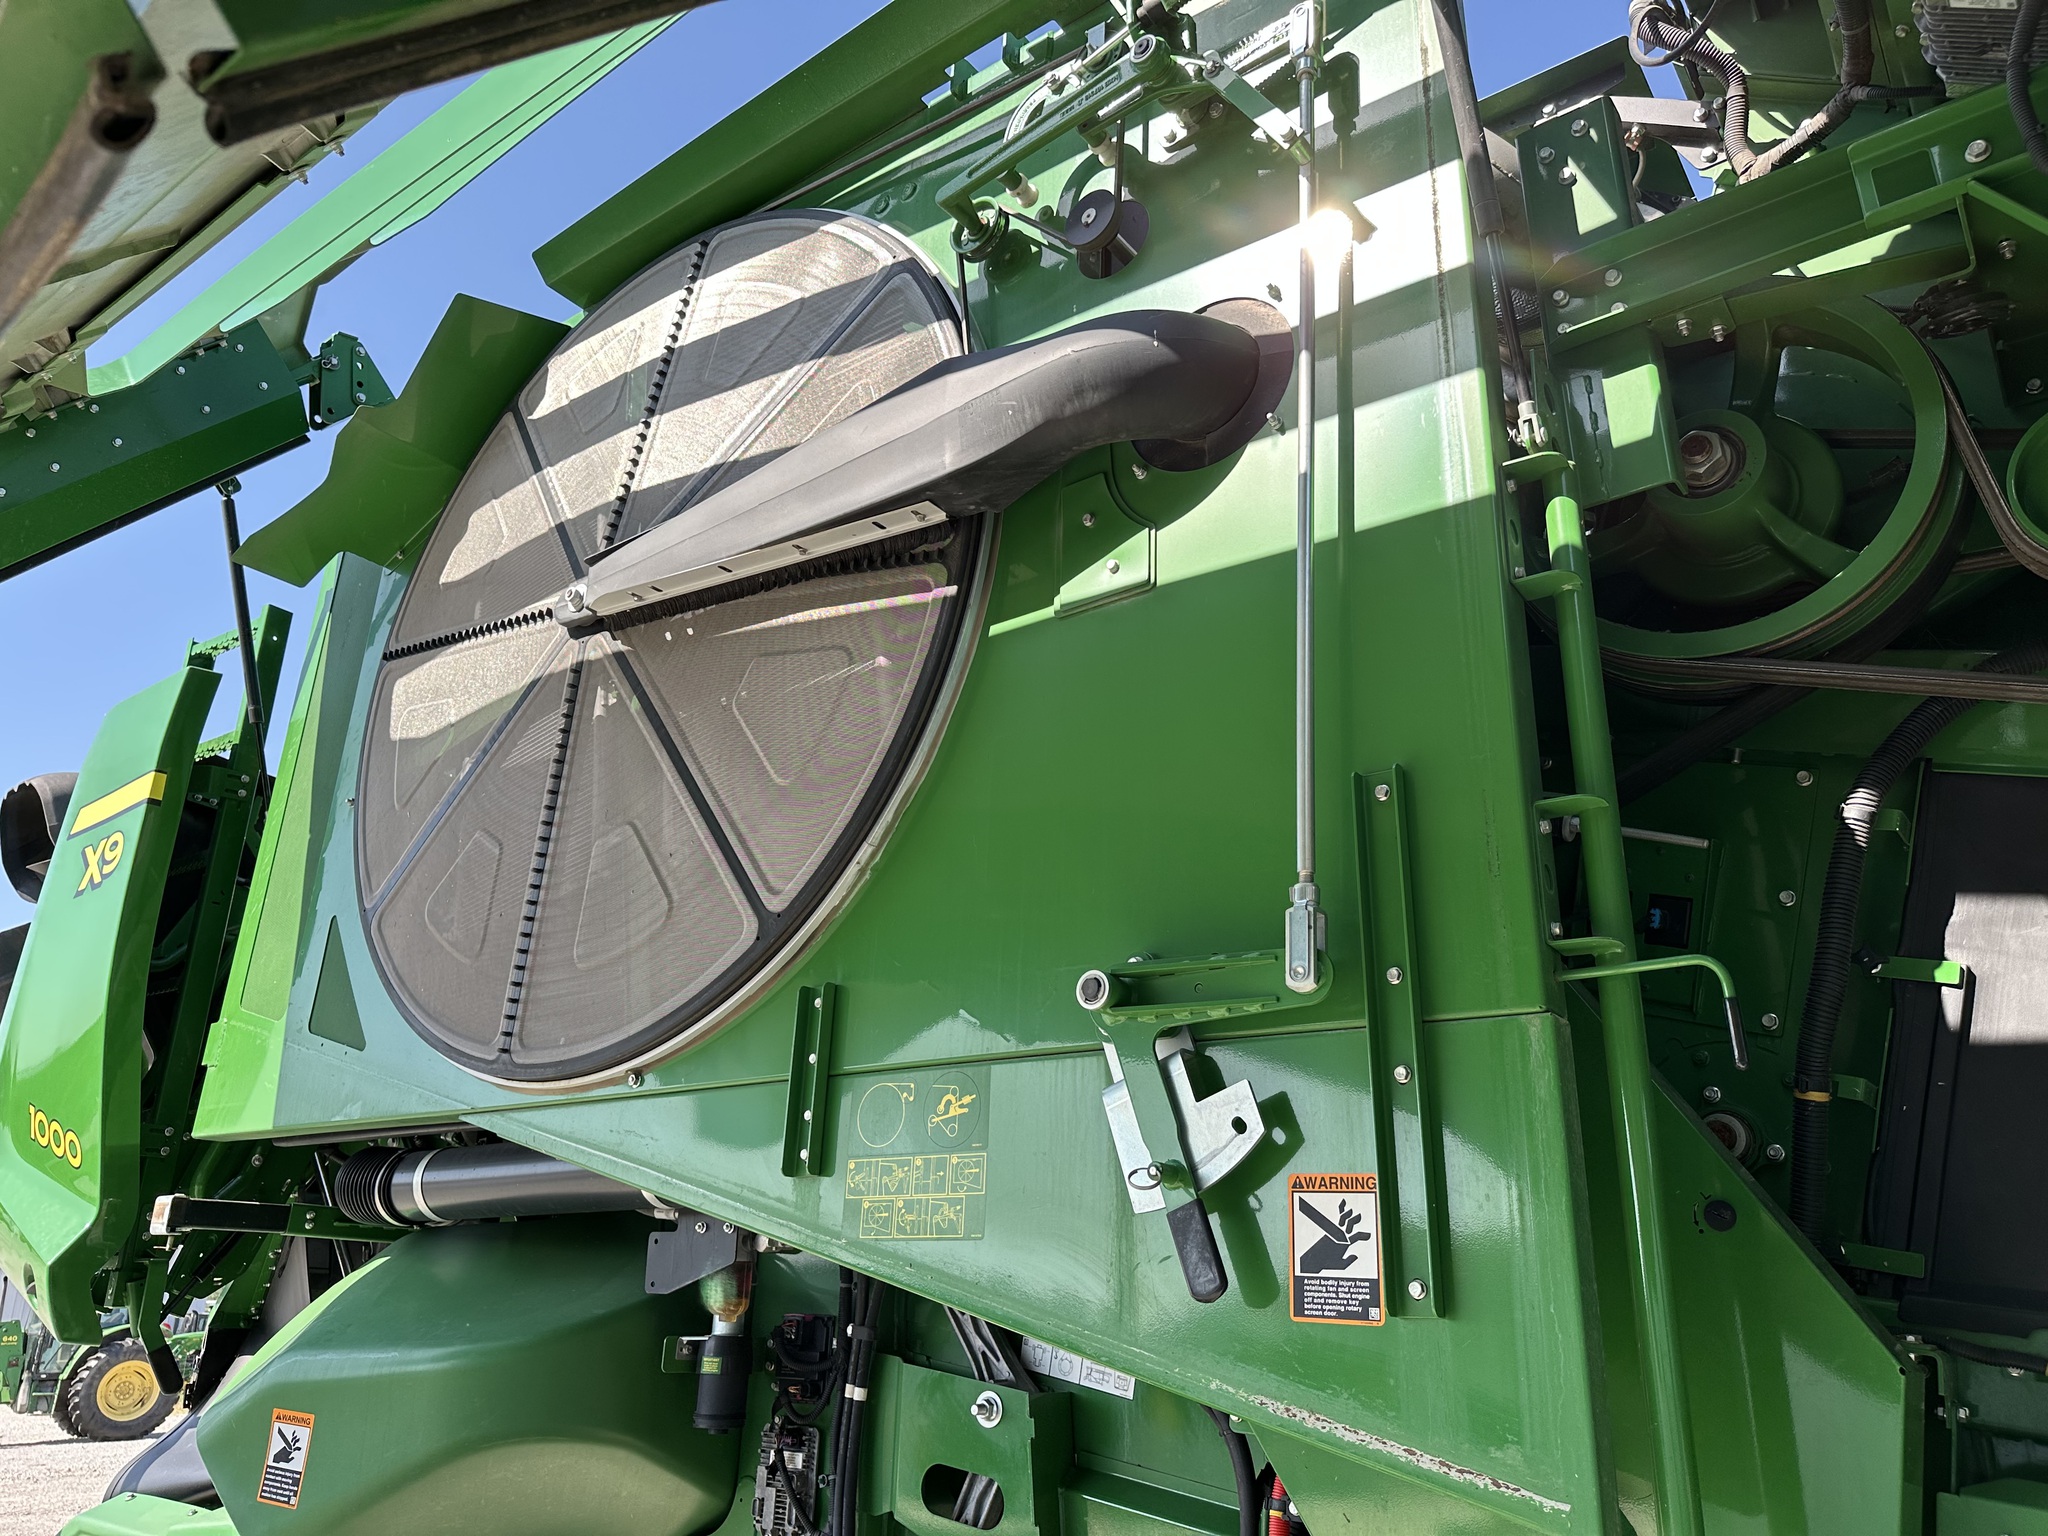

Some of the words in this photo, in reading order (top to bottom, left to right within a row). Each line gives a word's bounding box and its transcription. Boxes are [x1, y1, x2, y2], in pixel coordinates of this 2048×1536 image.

[73, 830, 125, 899] X9
[28, 1102, 83, 1170] 1000
[1304, 1176, 1376, 1190] WARNING
[282, 1413, 311, 1425] WARNING
